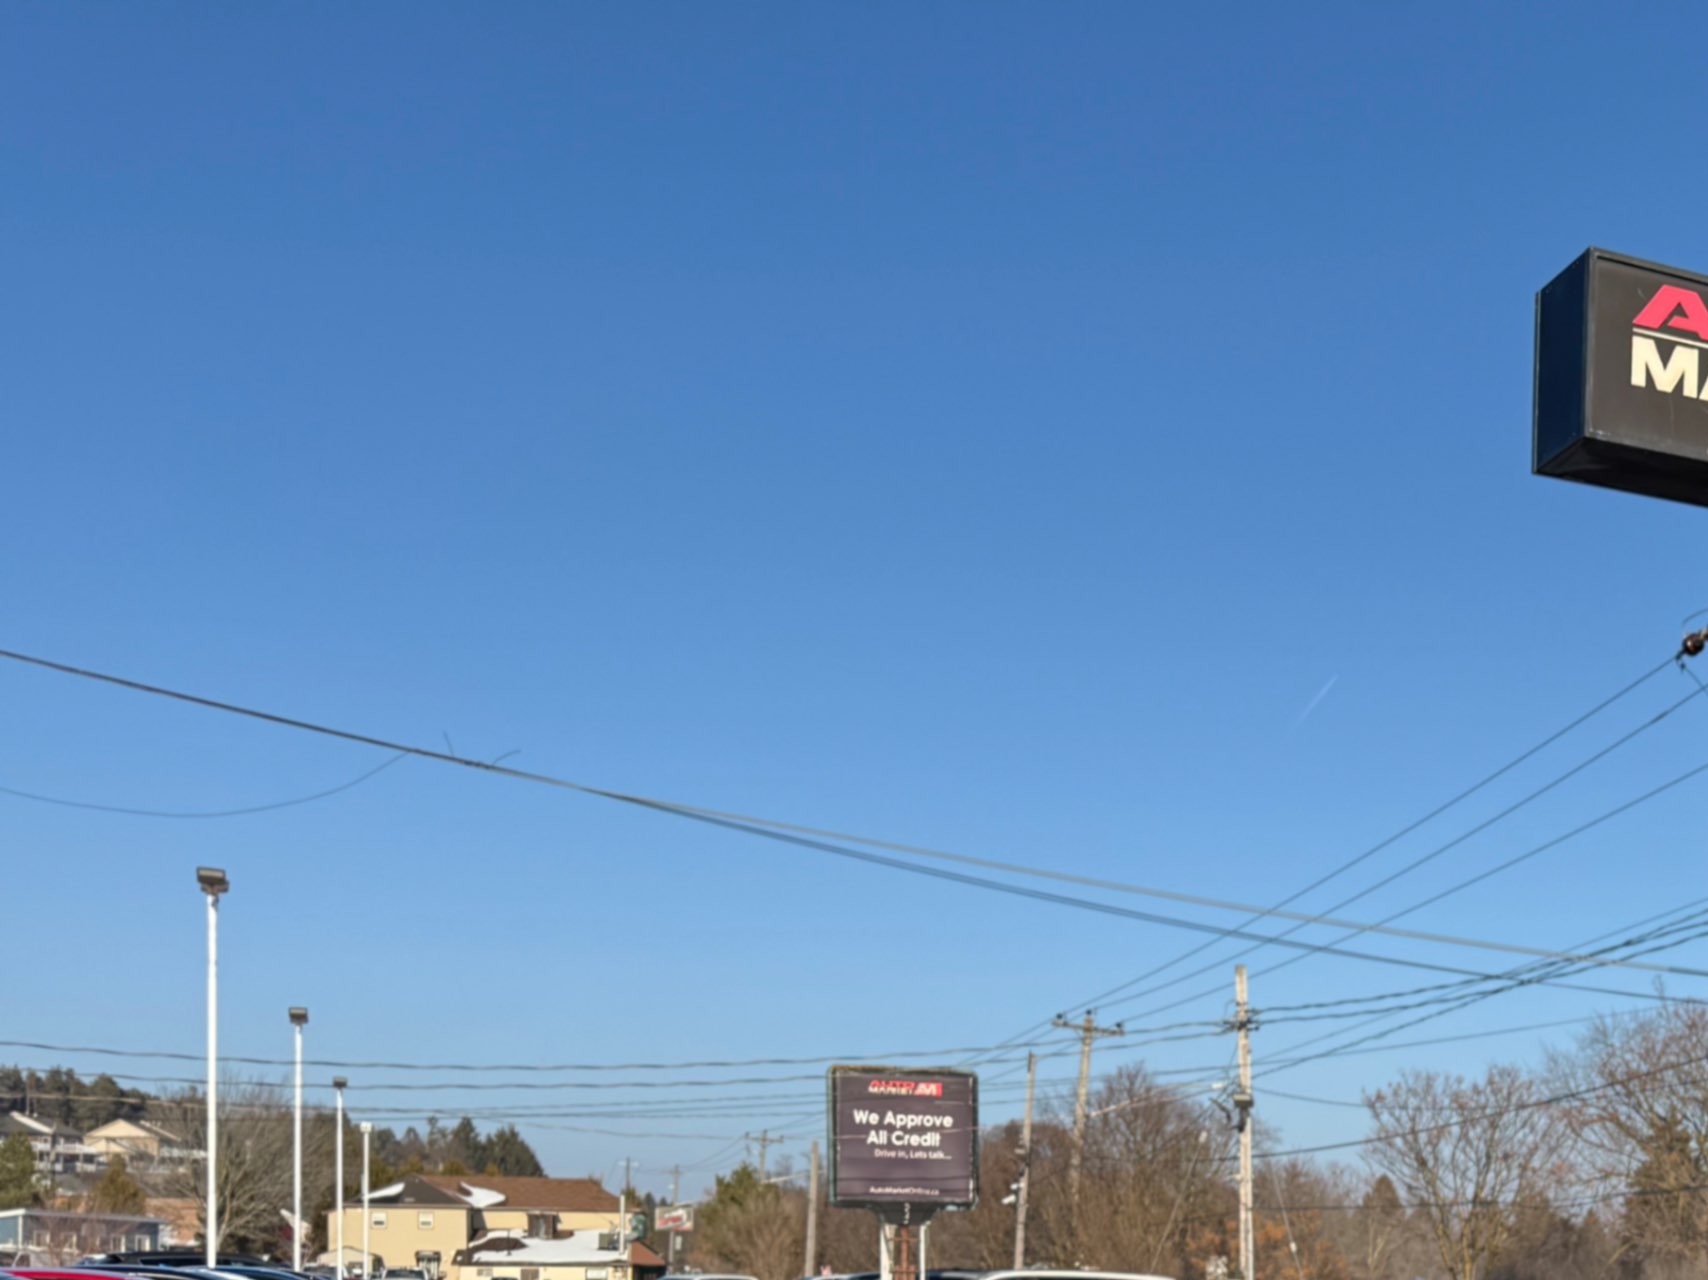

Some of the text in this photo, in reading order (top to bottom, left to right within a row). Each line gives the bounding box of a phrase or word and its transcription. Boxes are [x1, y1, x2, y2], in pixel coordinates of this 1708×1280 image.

[853, 1109, 954, 1129] We Approve
[866, 1129, 942, 1148] All Credit
[874, 1149, 896, 1158] Drive
